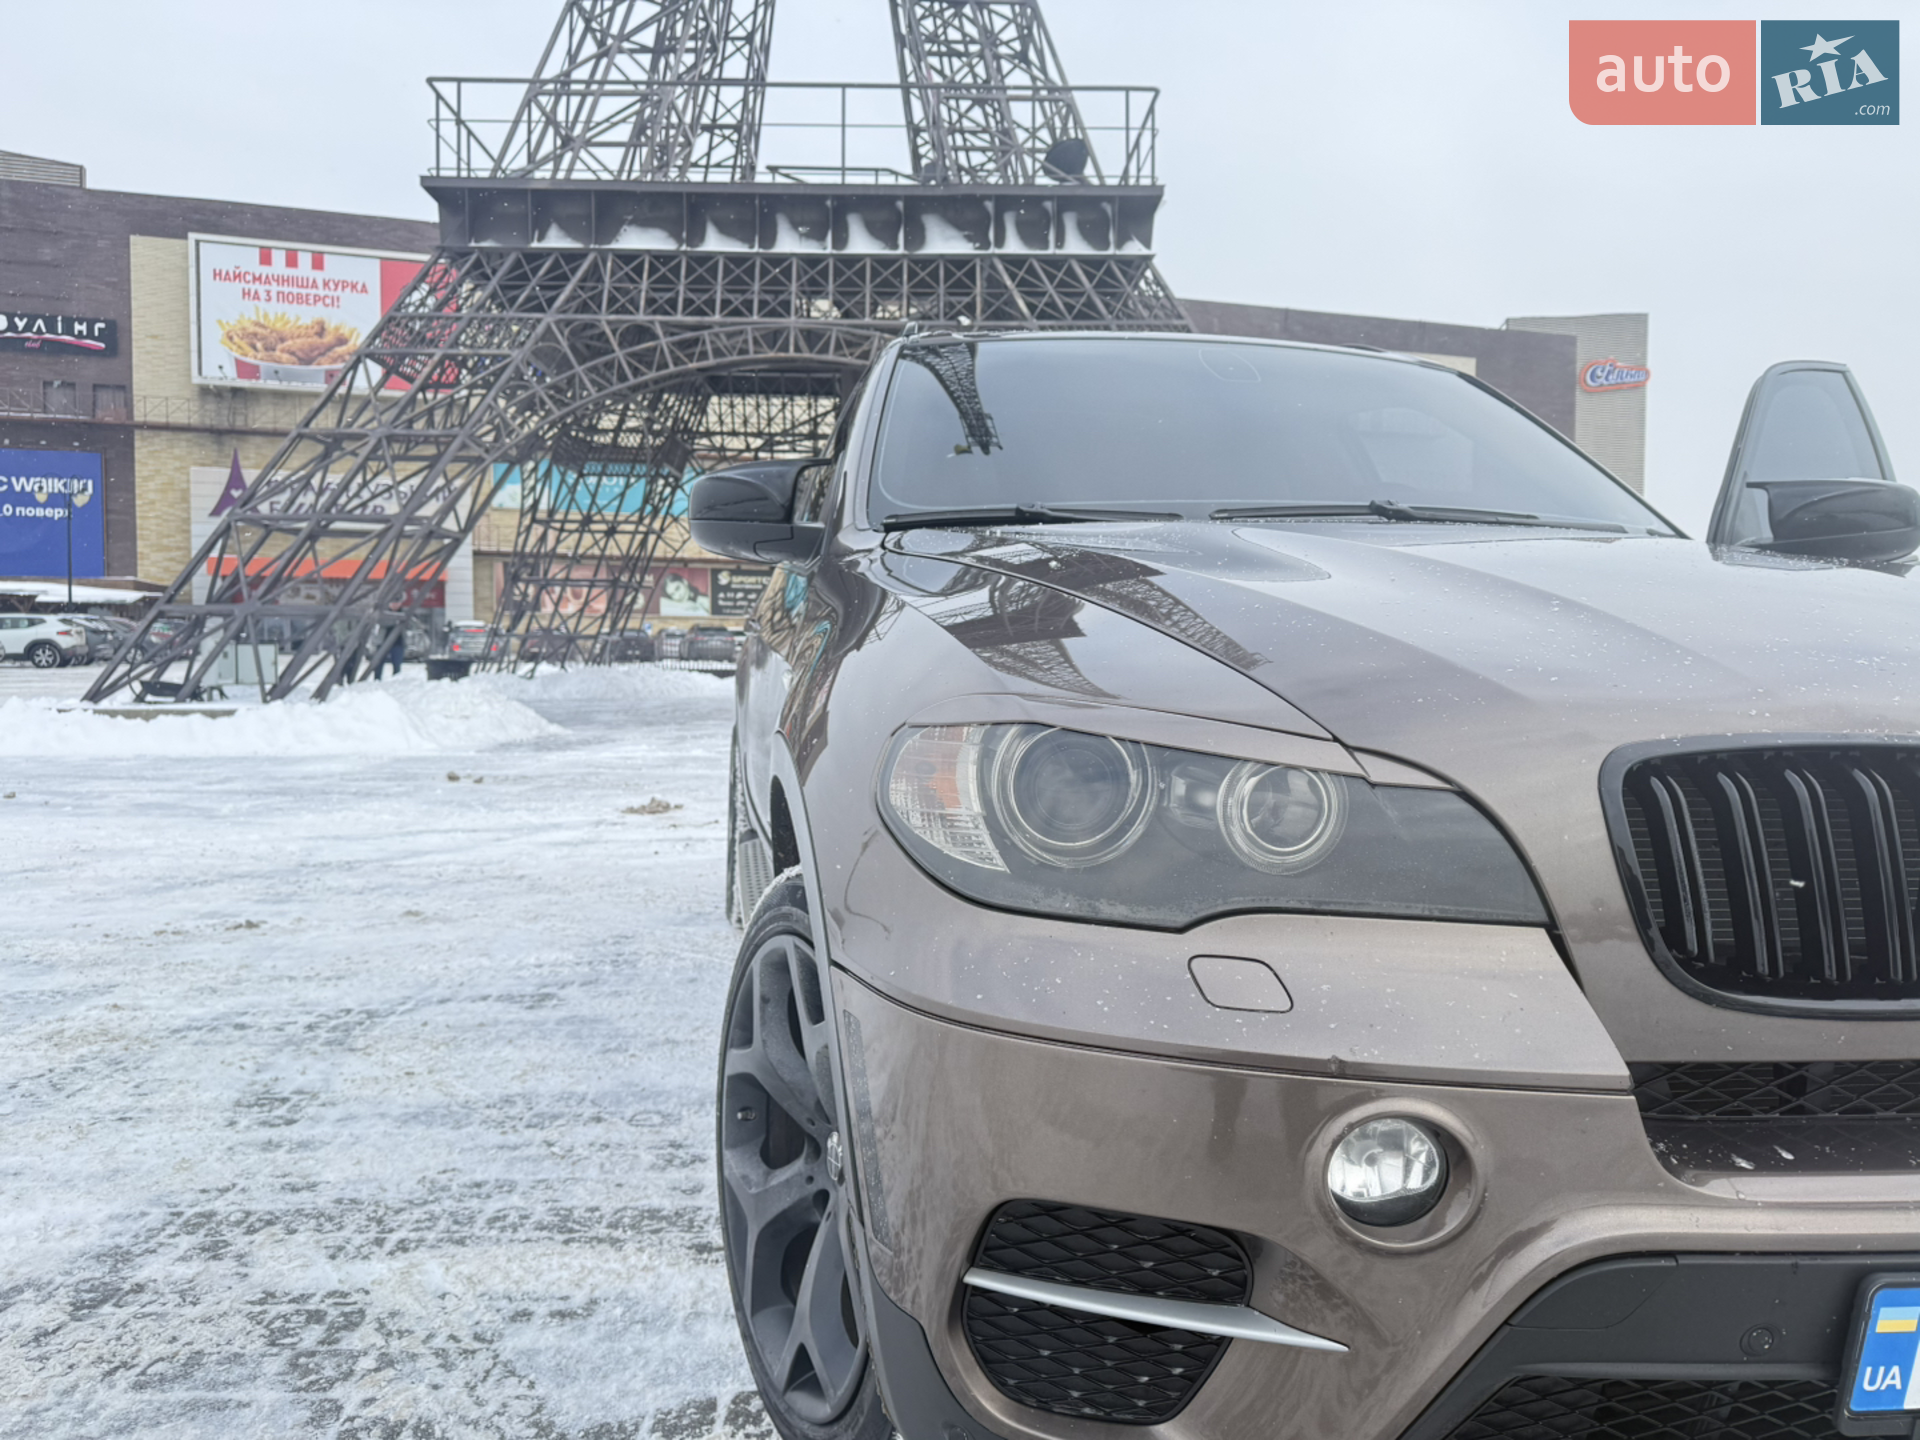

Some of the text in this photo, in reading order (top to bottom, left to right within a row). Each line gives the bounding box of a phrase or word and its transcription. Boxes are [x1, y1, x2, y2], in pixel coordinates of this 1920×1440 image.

[212, 265, 369, 295] НАЙСМАЧНІША КУРКА
[241, 286, 342, 309] НА 3 ПОВЕРСІ!
[1862, 1365, 1902, 1392] UA
